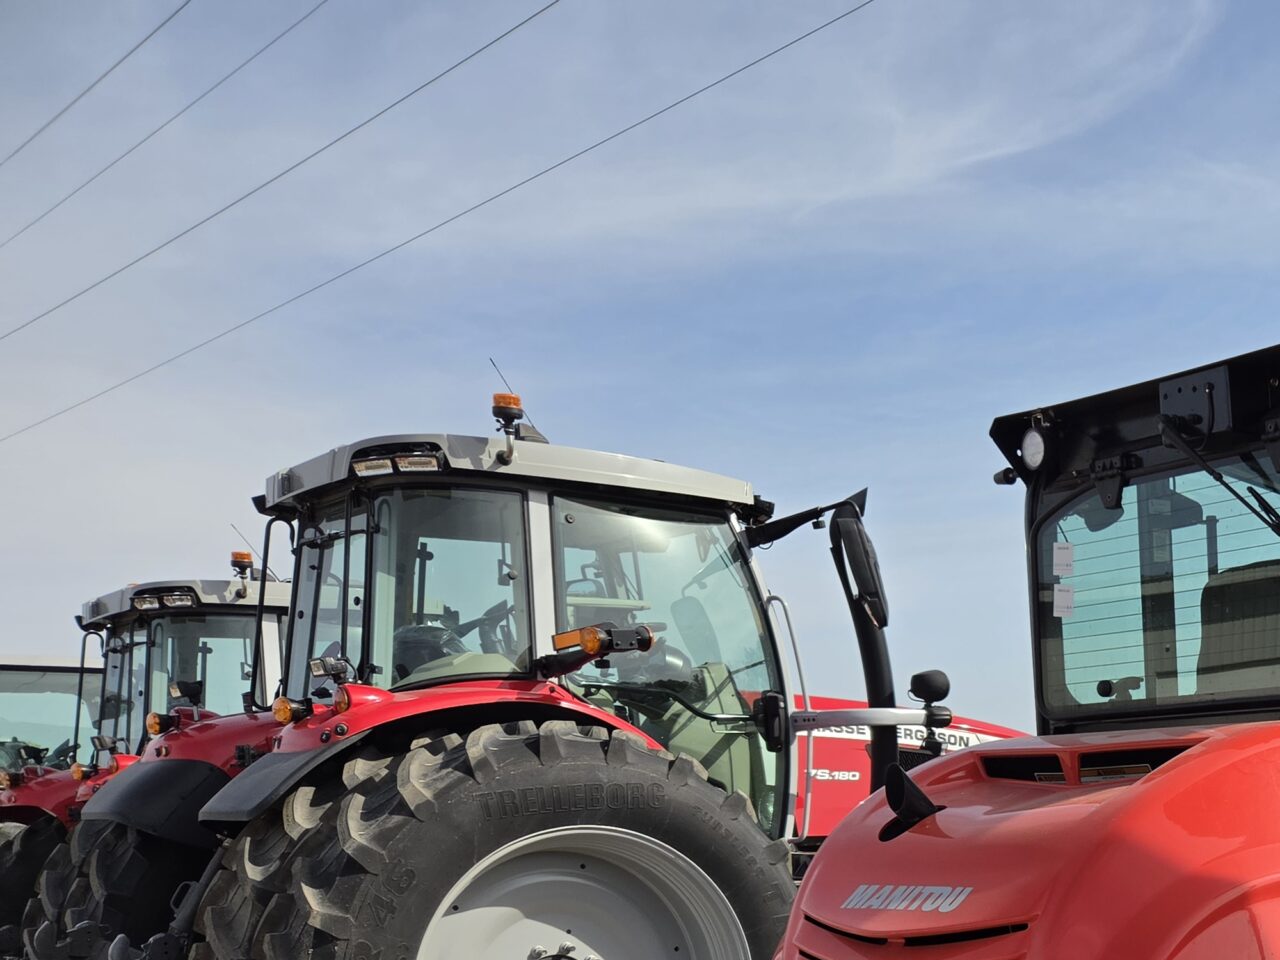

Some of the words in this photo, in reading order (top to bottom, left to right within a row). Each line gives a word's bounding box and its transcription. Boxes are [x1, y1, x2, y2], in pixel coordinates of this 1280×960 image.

[896, 726, 970, 748] ERGSON
[473, 782, 666, 821] TRELLEBORG
[840, 884, 973, 912] MANITOU
